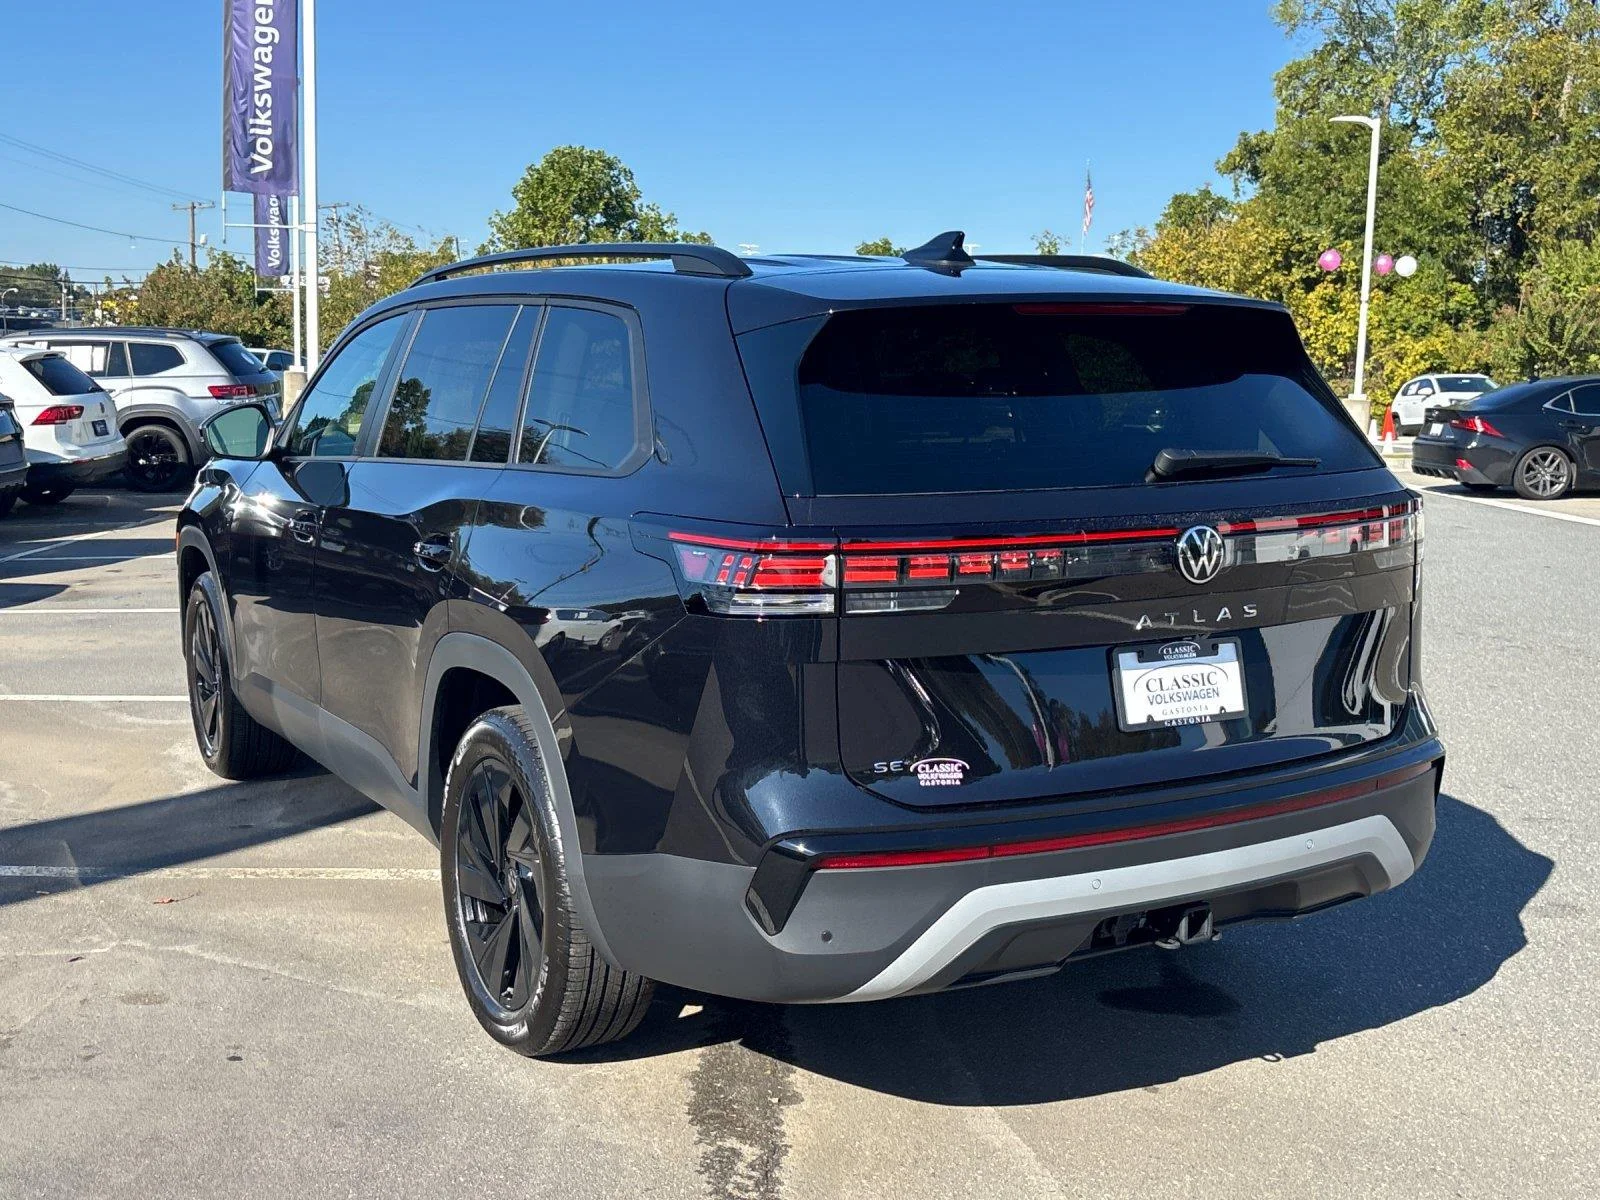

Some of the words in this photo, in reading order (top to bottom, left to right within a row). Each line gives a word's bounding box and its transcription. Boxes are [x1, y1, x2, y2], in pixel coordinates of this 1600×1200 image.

[249, 0, 280, 174] Volkswage
[1135, 604, 1257, 630] ATLAS
[1163, 645, 1197, 656] CLASSIC
[1145, 671, 1218, 693] CLASSIC
[1147, 687, 1220, 706] VOLKSWAGEN
[1162, 704, 1209, 716] GASTONIA
[1164, 715, 1212, 727] GASTONIA
[873, 760, 903, 773] SE
[917, 763, 962, 773] CLASSIC
[919, 779, 961, 787] GASTONIA
